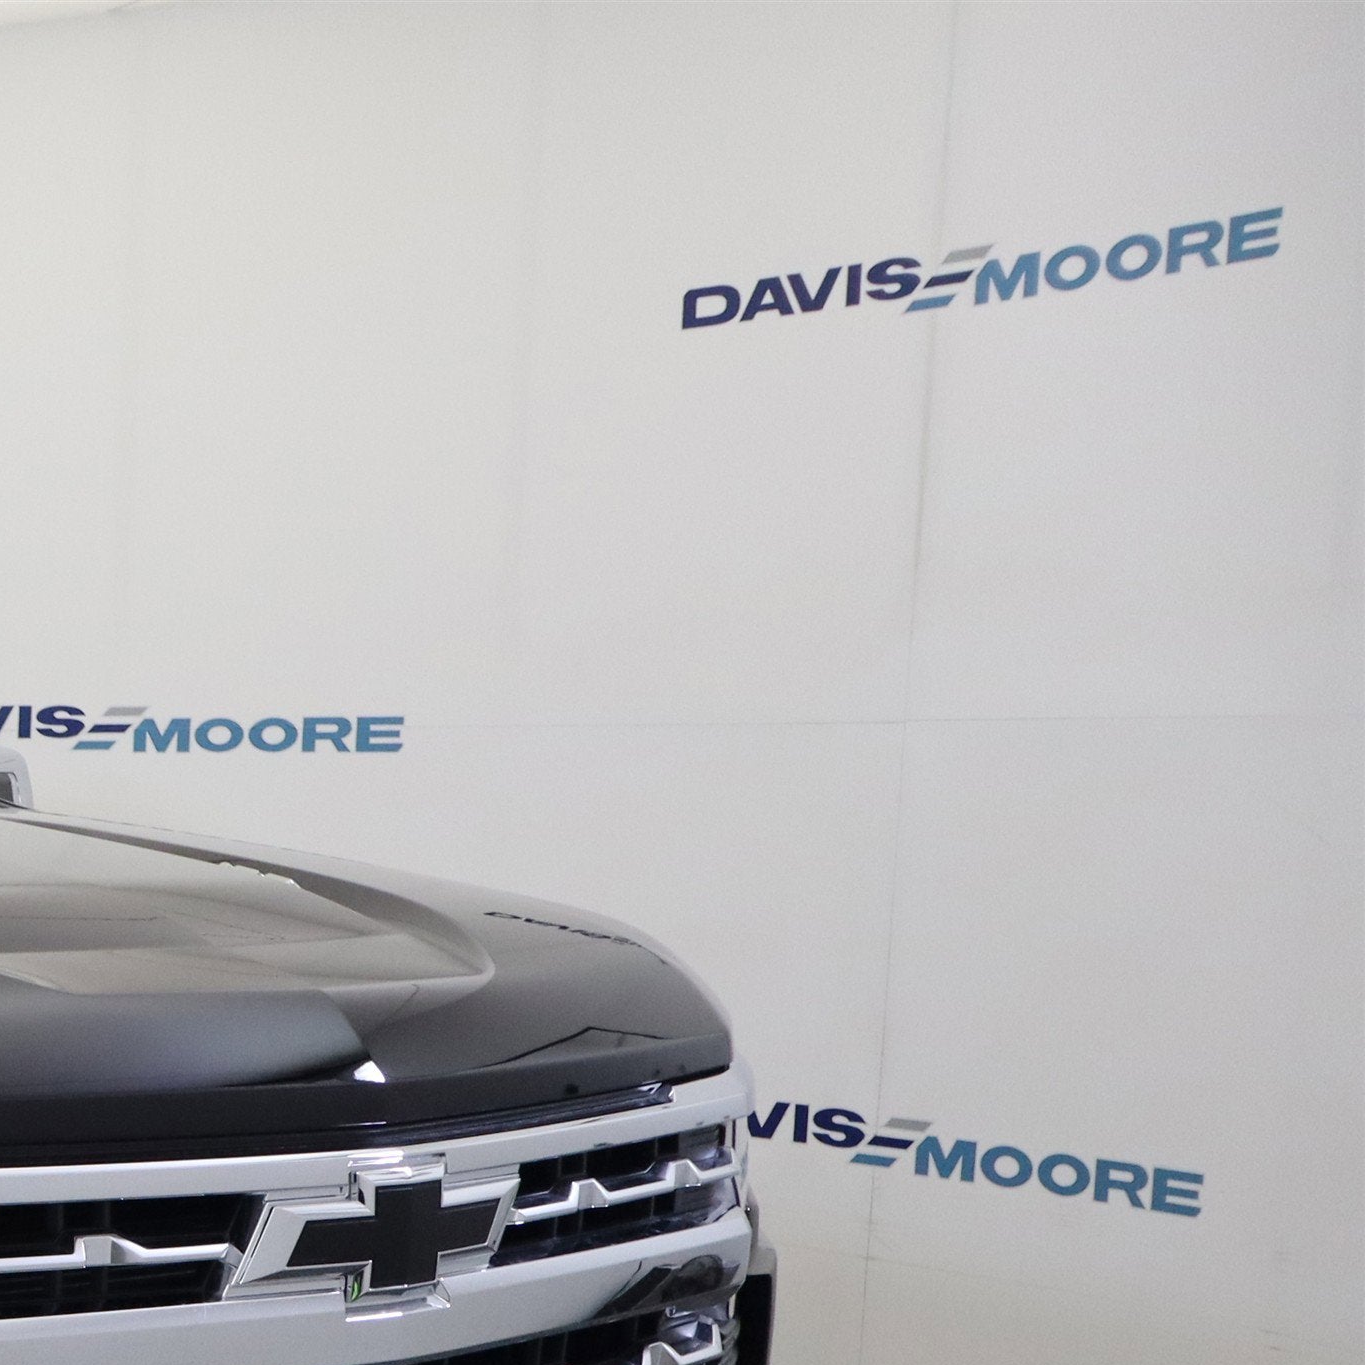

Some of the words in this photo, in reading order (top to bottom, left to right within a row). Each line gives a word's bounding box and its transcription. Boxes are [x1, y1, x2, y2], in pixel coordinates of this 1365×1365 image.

[681, 256, 924, 330] DAVIS
[973, 206, 1284, 306] MOORE
[132, 715, 405, 753] MOORE
[747, 1101, 867, 1148] VIS
[914, 1135, 1204, 1217] MOORE
